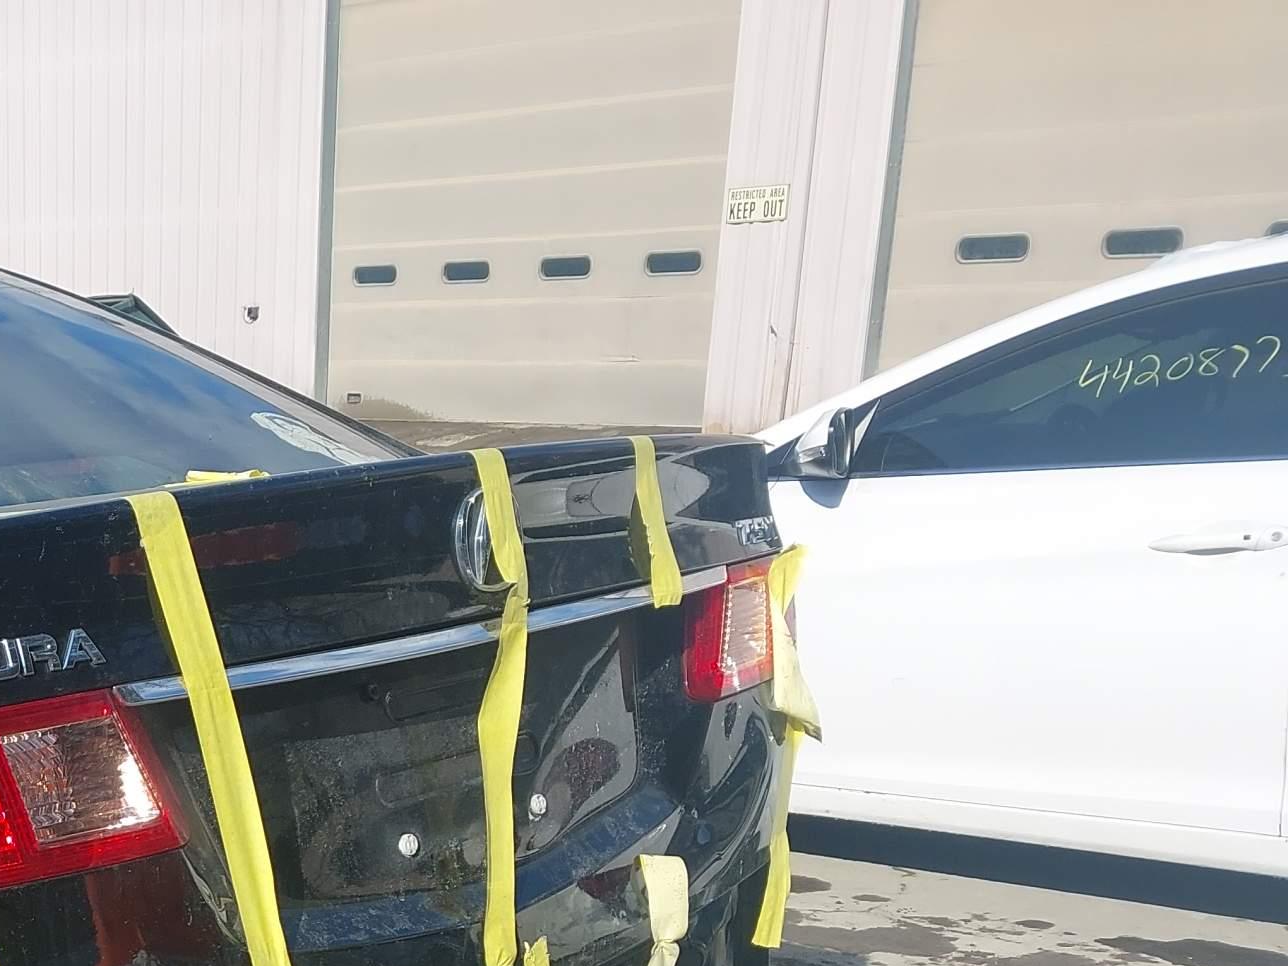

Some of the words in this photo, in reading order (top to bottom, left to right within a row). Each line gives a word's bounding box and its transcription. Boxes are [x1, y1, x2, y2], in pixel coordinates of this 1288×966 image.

[730, 190, 767, 201] RESTRICTED
[769, 187, 785, 199] AREA
[728, 201, 756, 220] KEEP
[763, 199, 785, 218] OUT
[1078, 335, 1288, 399] 4420877
